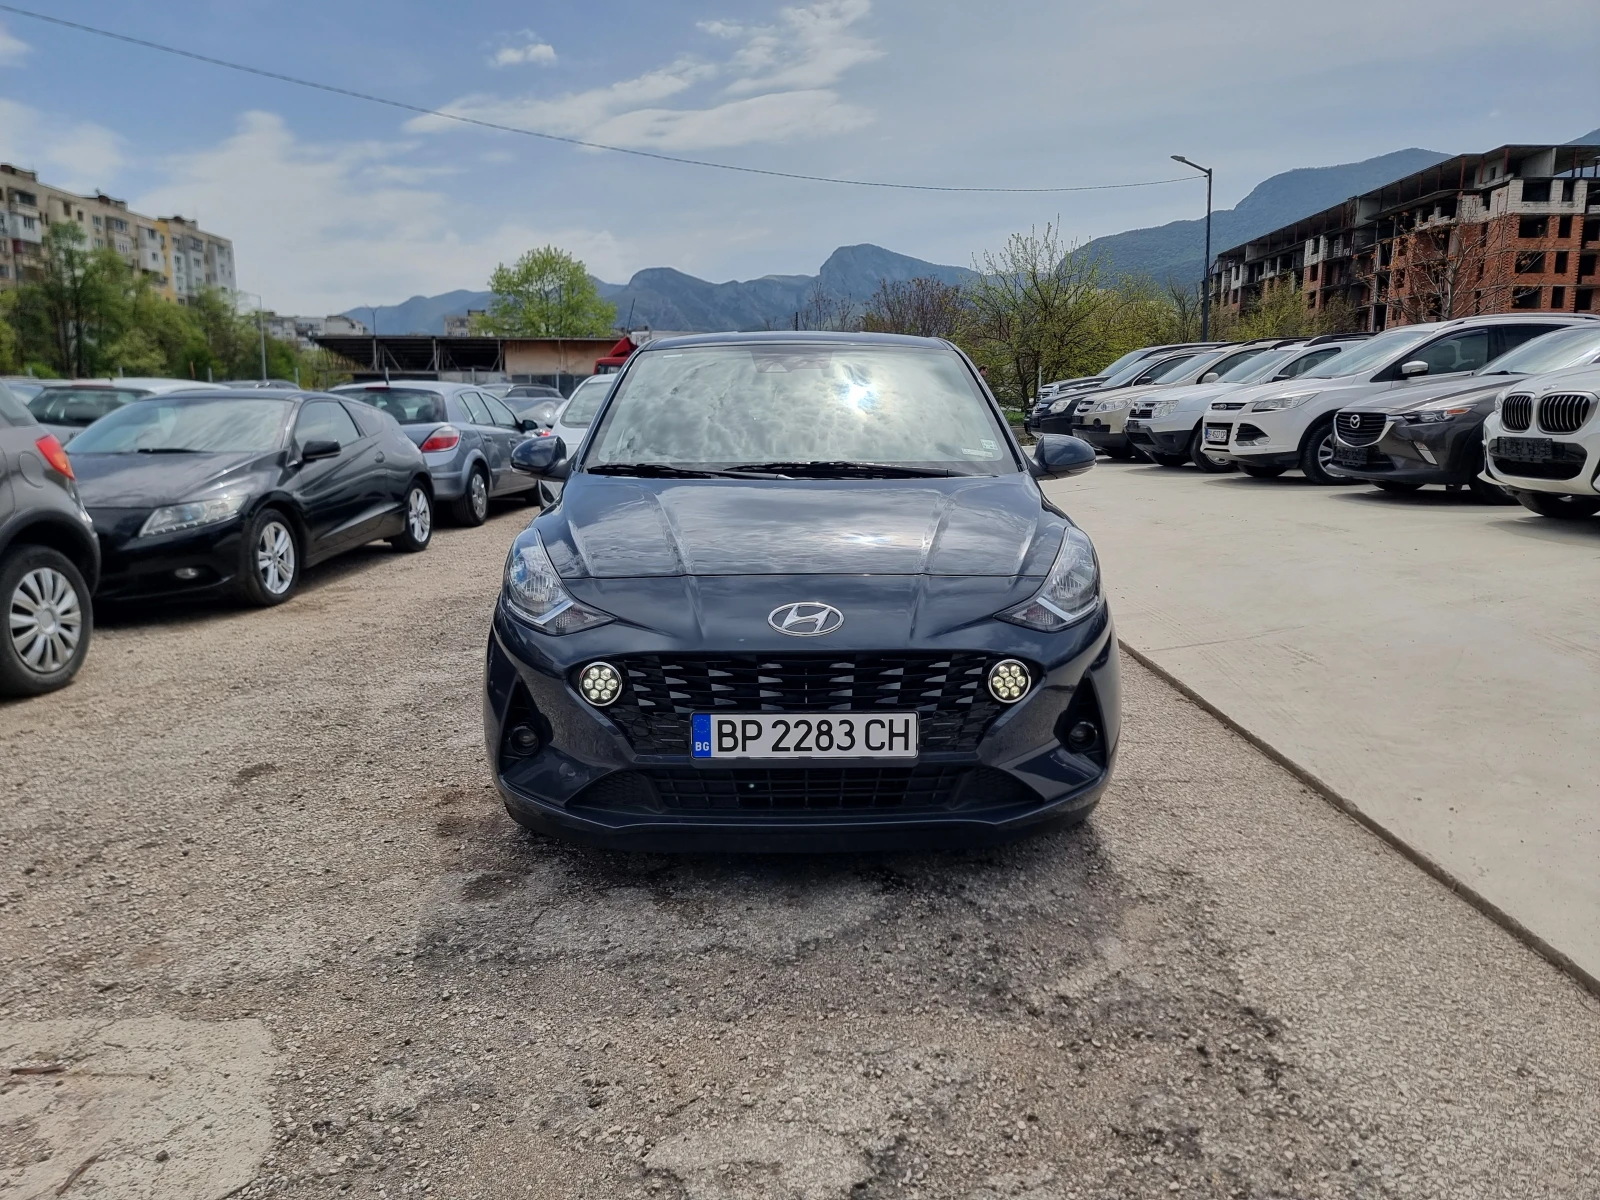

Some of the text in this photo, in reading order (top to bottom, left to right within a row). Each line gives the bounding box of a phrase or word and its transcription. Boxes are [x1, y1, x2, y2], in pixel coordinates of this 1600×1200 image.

[717, 718, 910, 752] BP 2283 CH
[694, 741, 710, 752] BG
